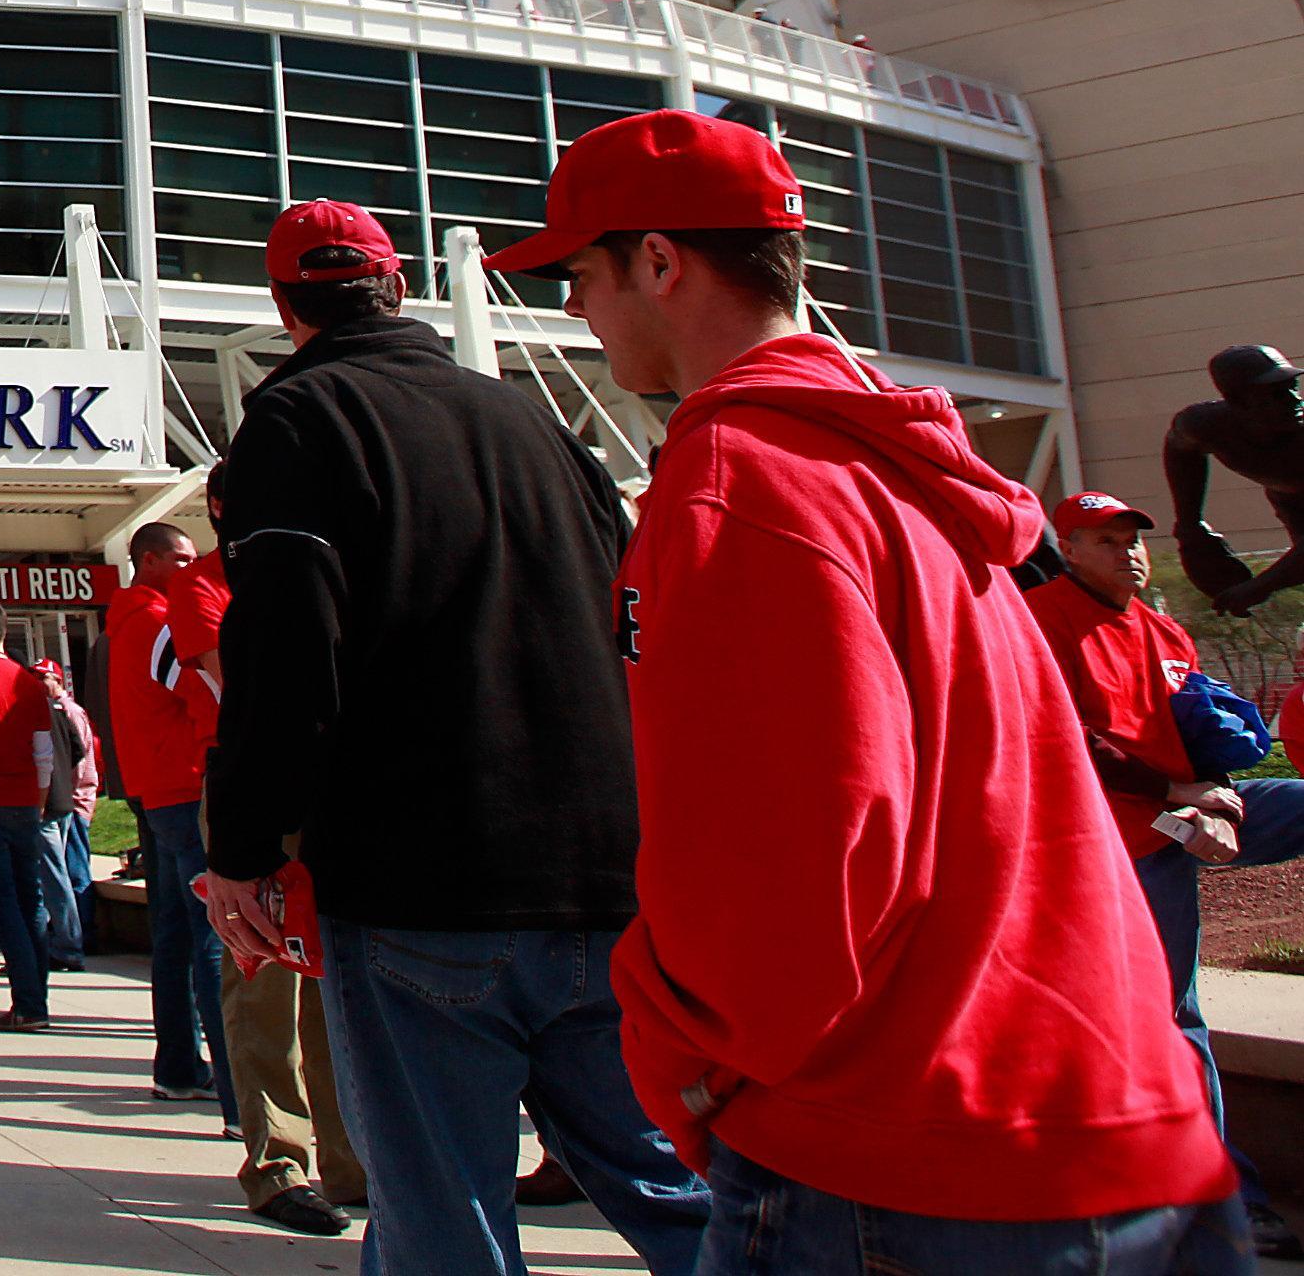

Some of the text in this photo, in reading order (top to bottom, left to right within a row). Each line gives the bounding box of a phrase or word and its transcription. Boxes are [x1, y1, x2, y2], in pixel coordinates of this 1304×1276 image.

[110, 438, 135, 452] SM
[29, 568, 93, 601] REDS
[1168, 669, 1188, 682] RE
